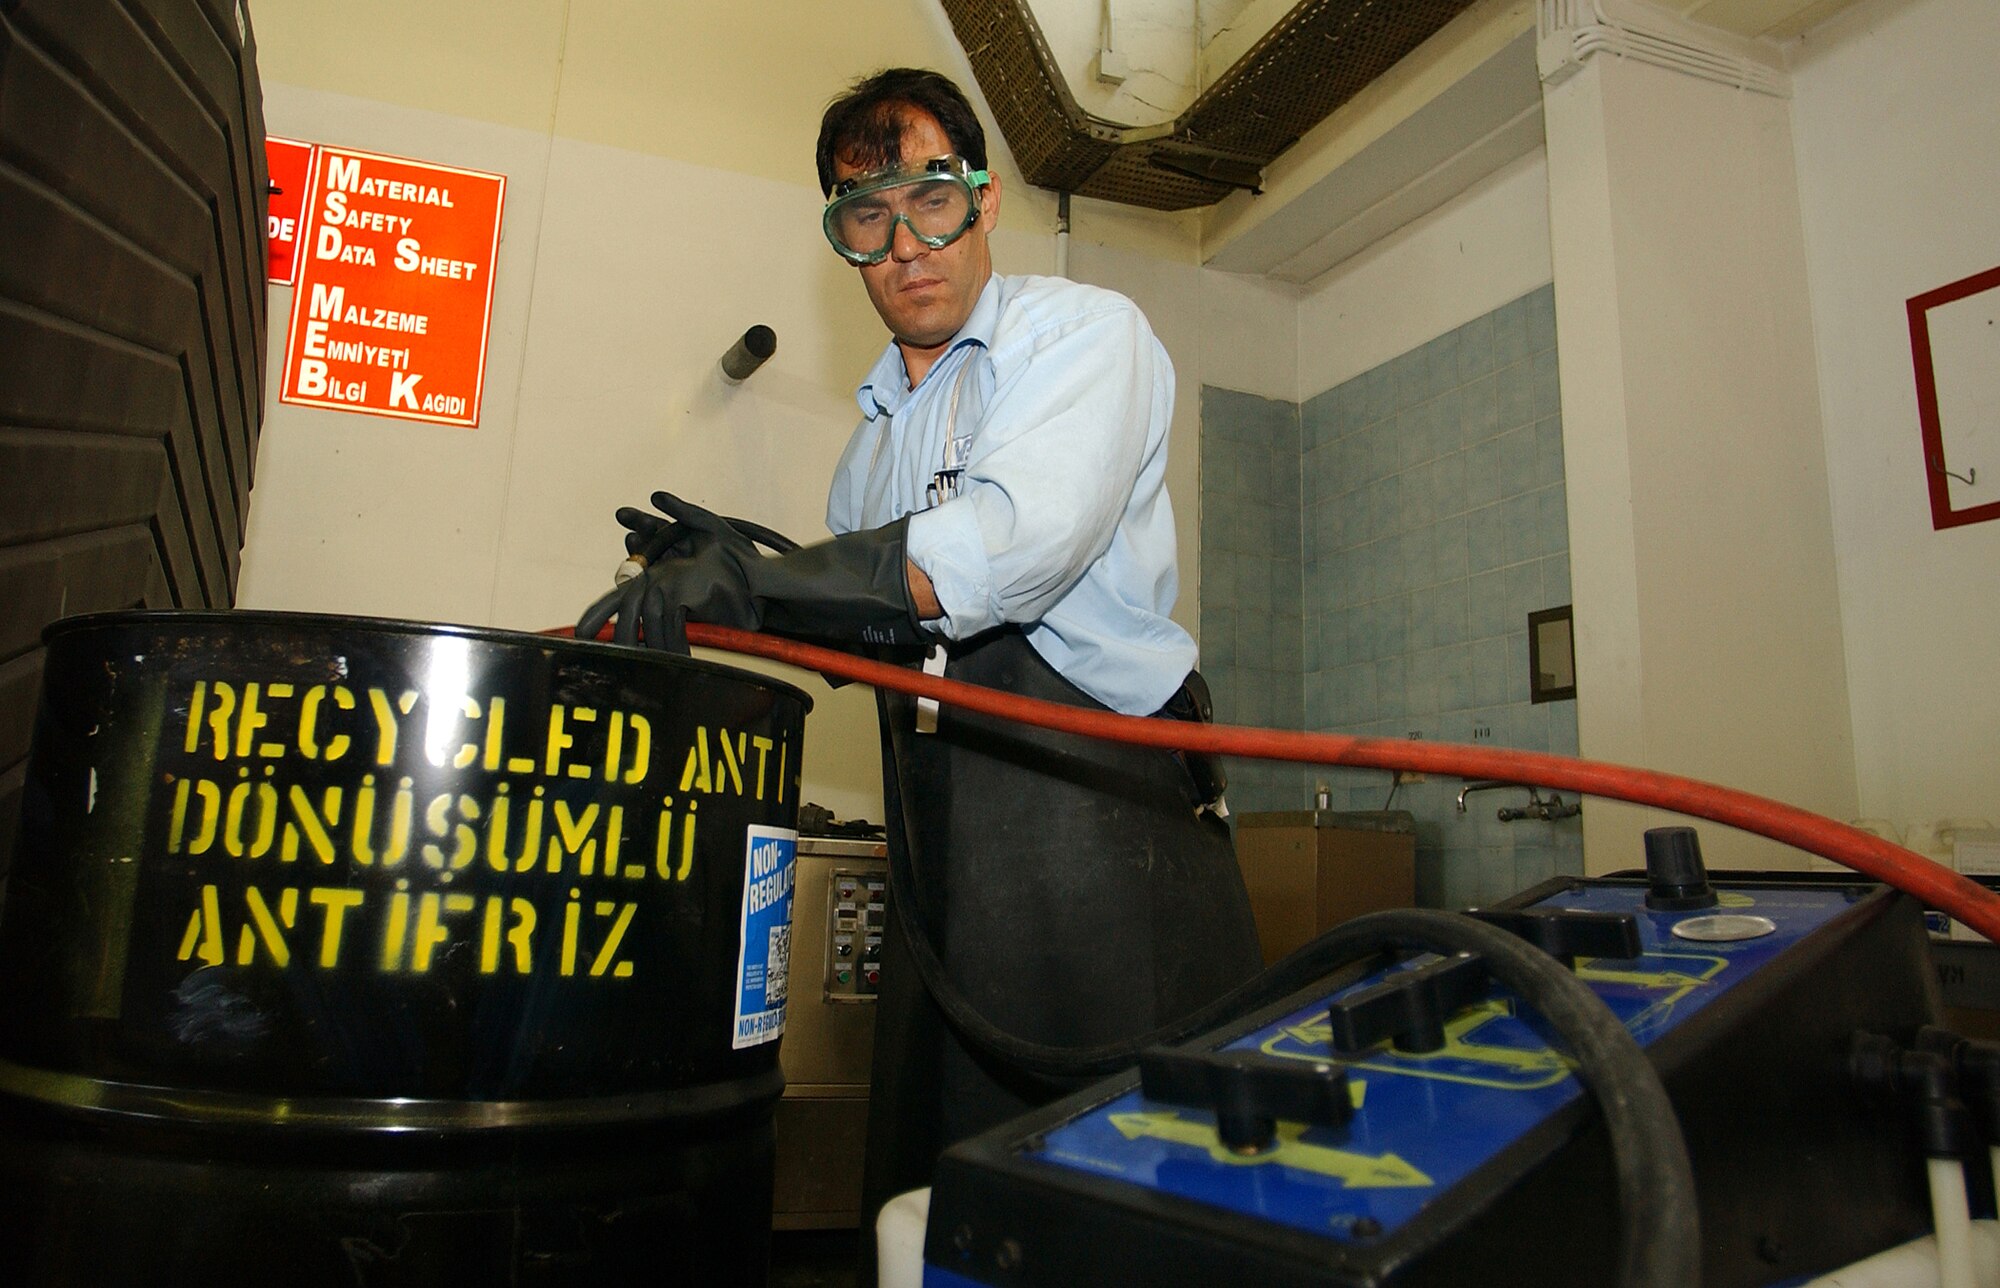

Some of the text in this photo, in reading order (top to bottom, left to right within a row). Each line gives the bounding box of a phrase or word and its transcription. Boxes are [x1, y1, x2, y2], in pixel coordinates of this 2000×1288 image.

[327, 156, 454, 208] MATERIAL
[323, 191, 412, 236] SAFETY
[316, 225, 477, 281] DATA SHEET
[309, 283, 428, 335] MALZEME
[304, 321, 410, 370] EMNİYETİ
[184, 680, 652, 785] RECYCLED
[753, 840, 782, 879] NON-
